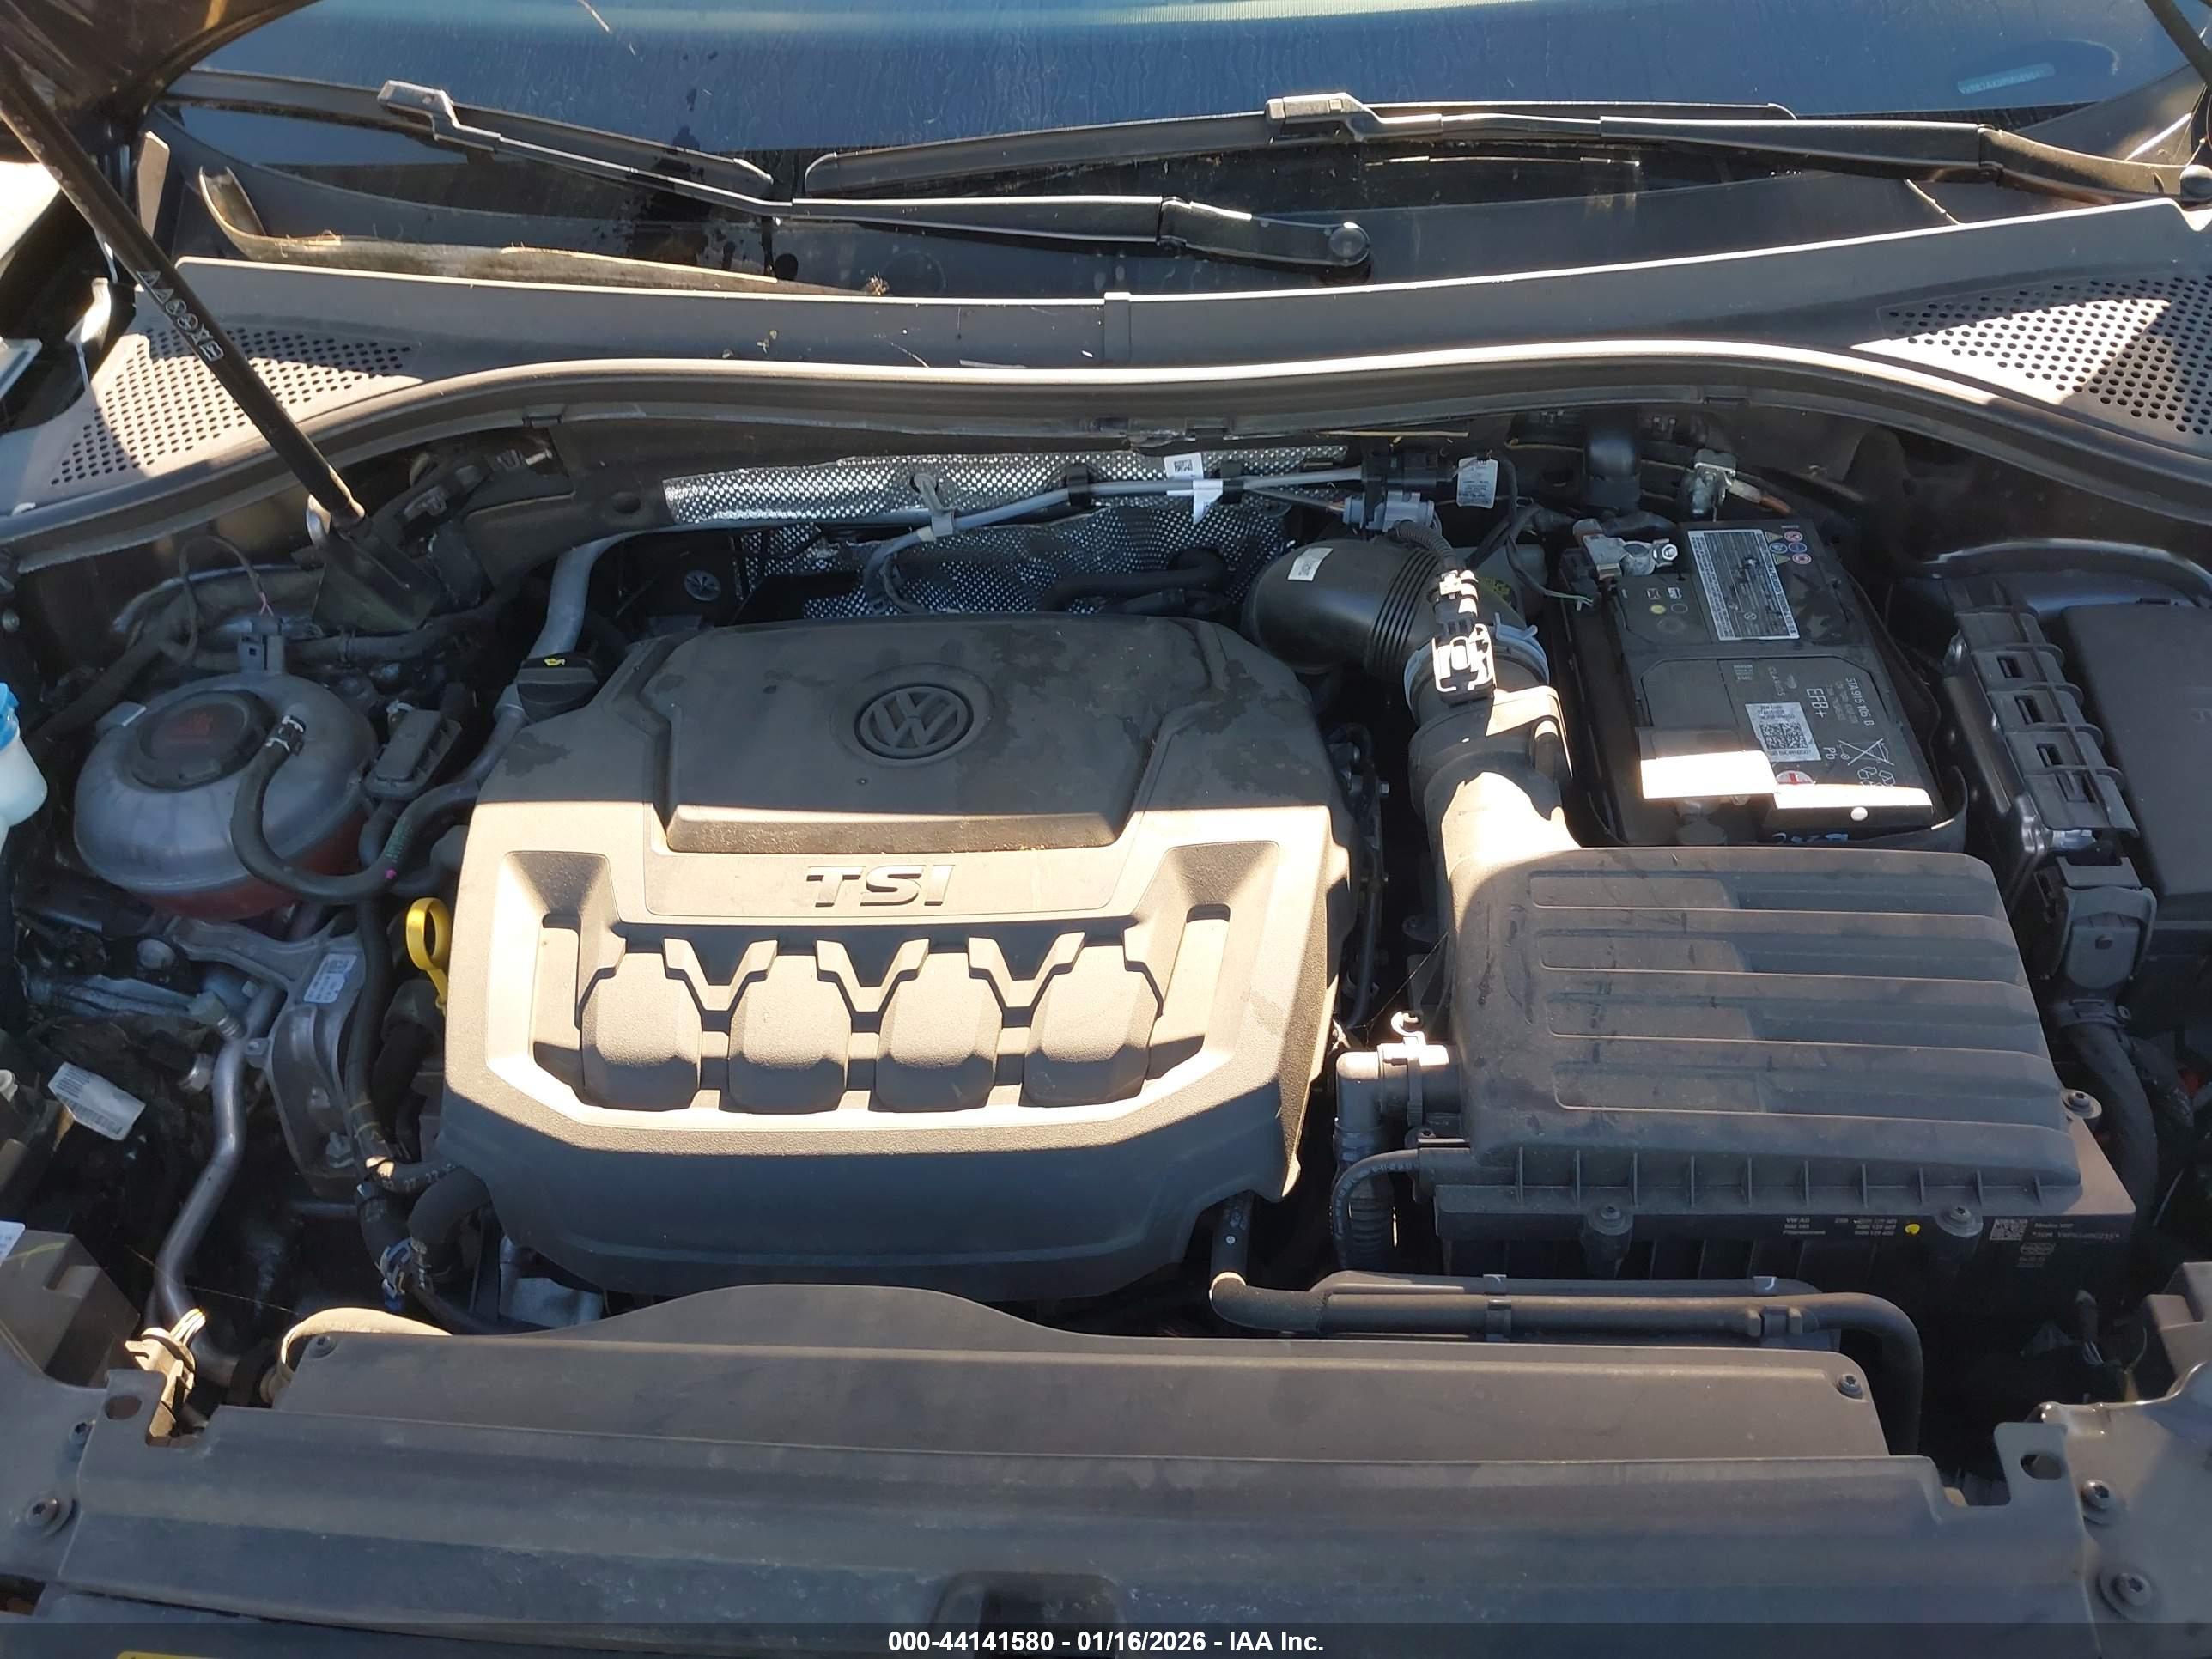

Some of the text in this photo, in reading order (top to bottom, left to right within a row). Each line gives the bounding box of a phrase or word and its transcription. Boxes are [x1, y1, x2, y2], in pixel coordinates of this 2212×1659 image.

[1806, 687, 1829, 718] EFB+
[1851, 690, 1865, 703] 915
[856, 684, 971, 757] VW
[1856, 704, 1871, 718] 105
[1822, 746, 1837, 760] Pb
[806, 864, 956, 908] TSI
